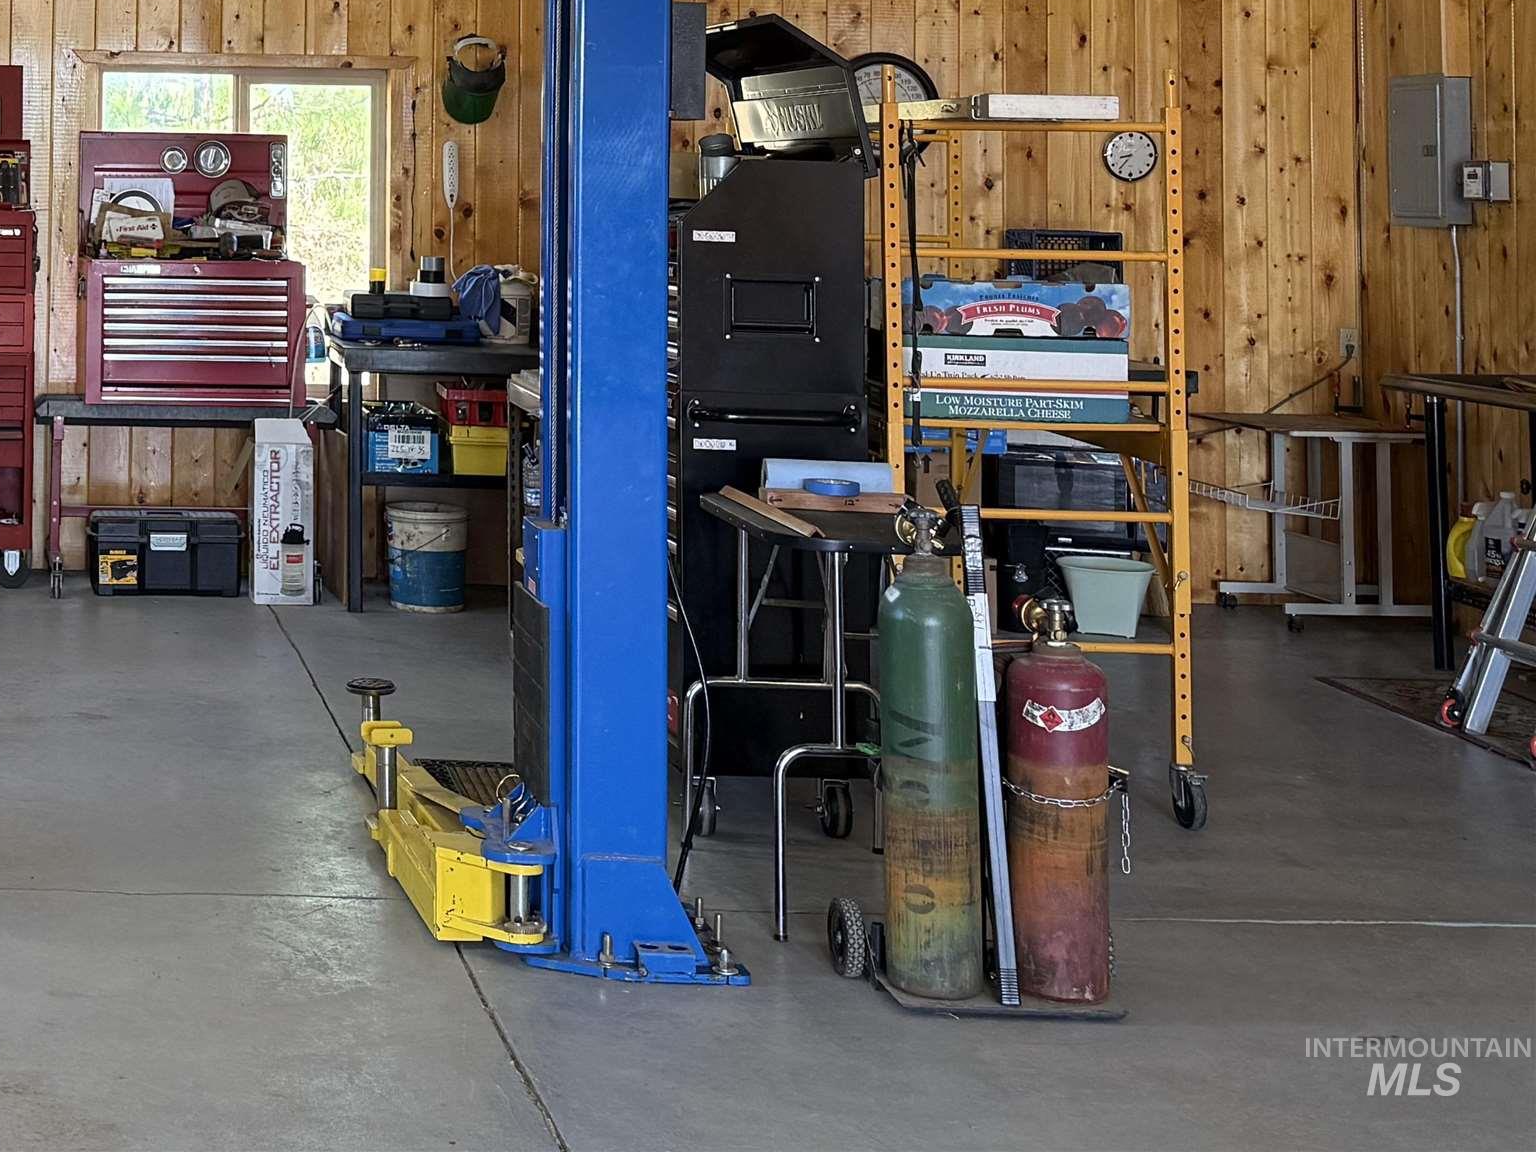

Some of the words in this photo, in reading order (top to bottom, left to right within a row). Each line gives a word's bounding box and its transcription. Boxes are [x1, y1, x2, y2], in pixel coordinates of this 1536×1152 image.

[976, 305, 1005, 315] FRESH
[1009, 304, 1041, 316] PLUMS
[946, 354, 985, 362] KIRKLAND
[935, 394, 961, 405] LOW
[963, 395, 1023, 408] MOISTURE
[1025, 397, 1084, 410] PART-SKIM
[948, 405, 1025, 417] MOZZARELLA
[1027, 407, 1072, 419] CHEESE
[269, 448, 281, 544] EXTRACTOR
[269, 549, 280, 571] EL
